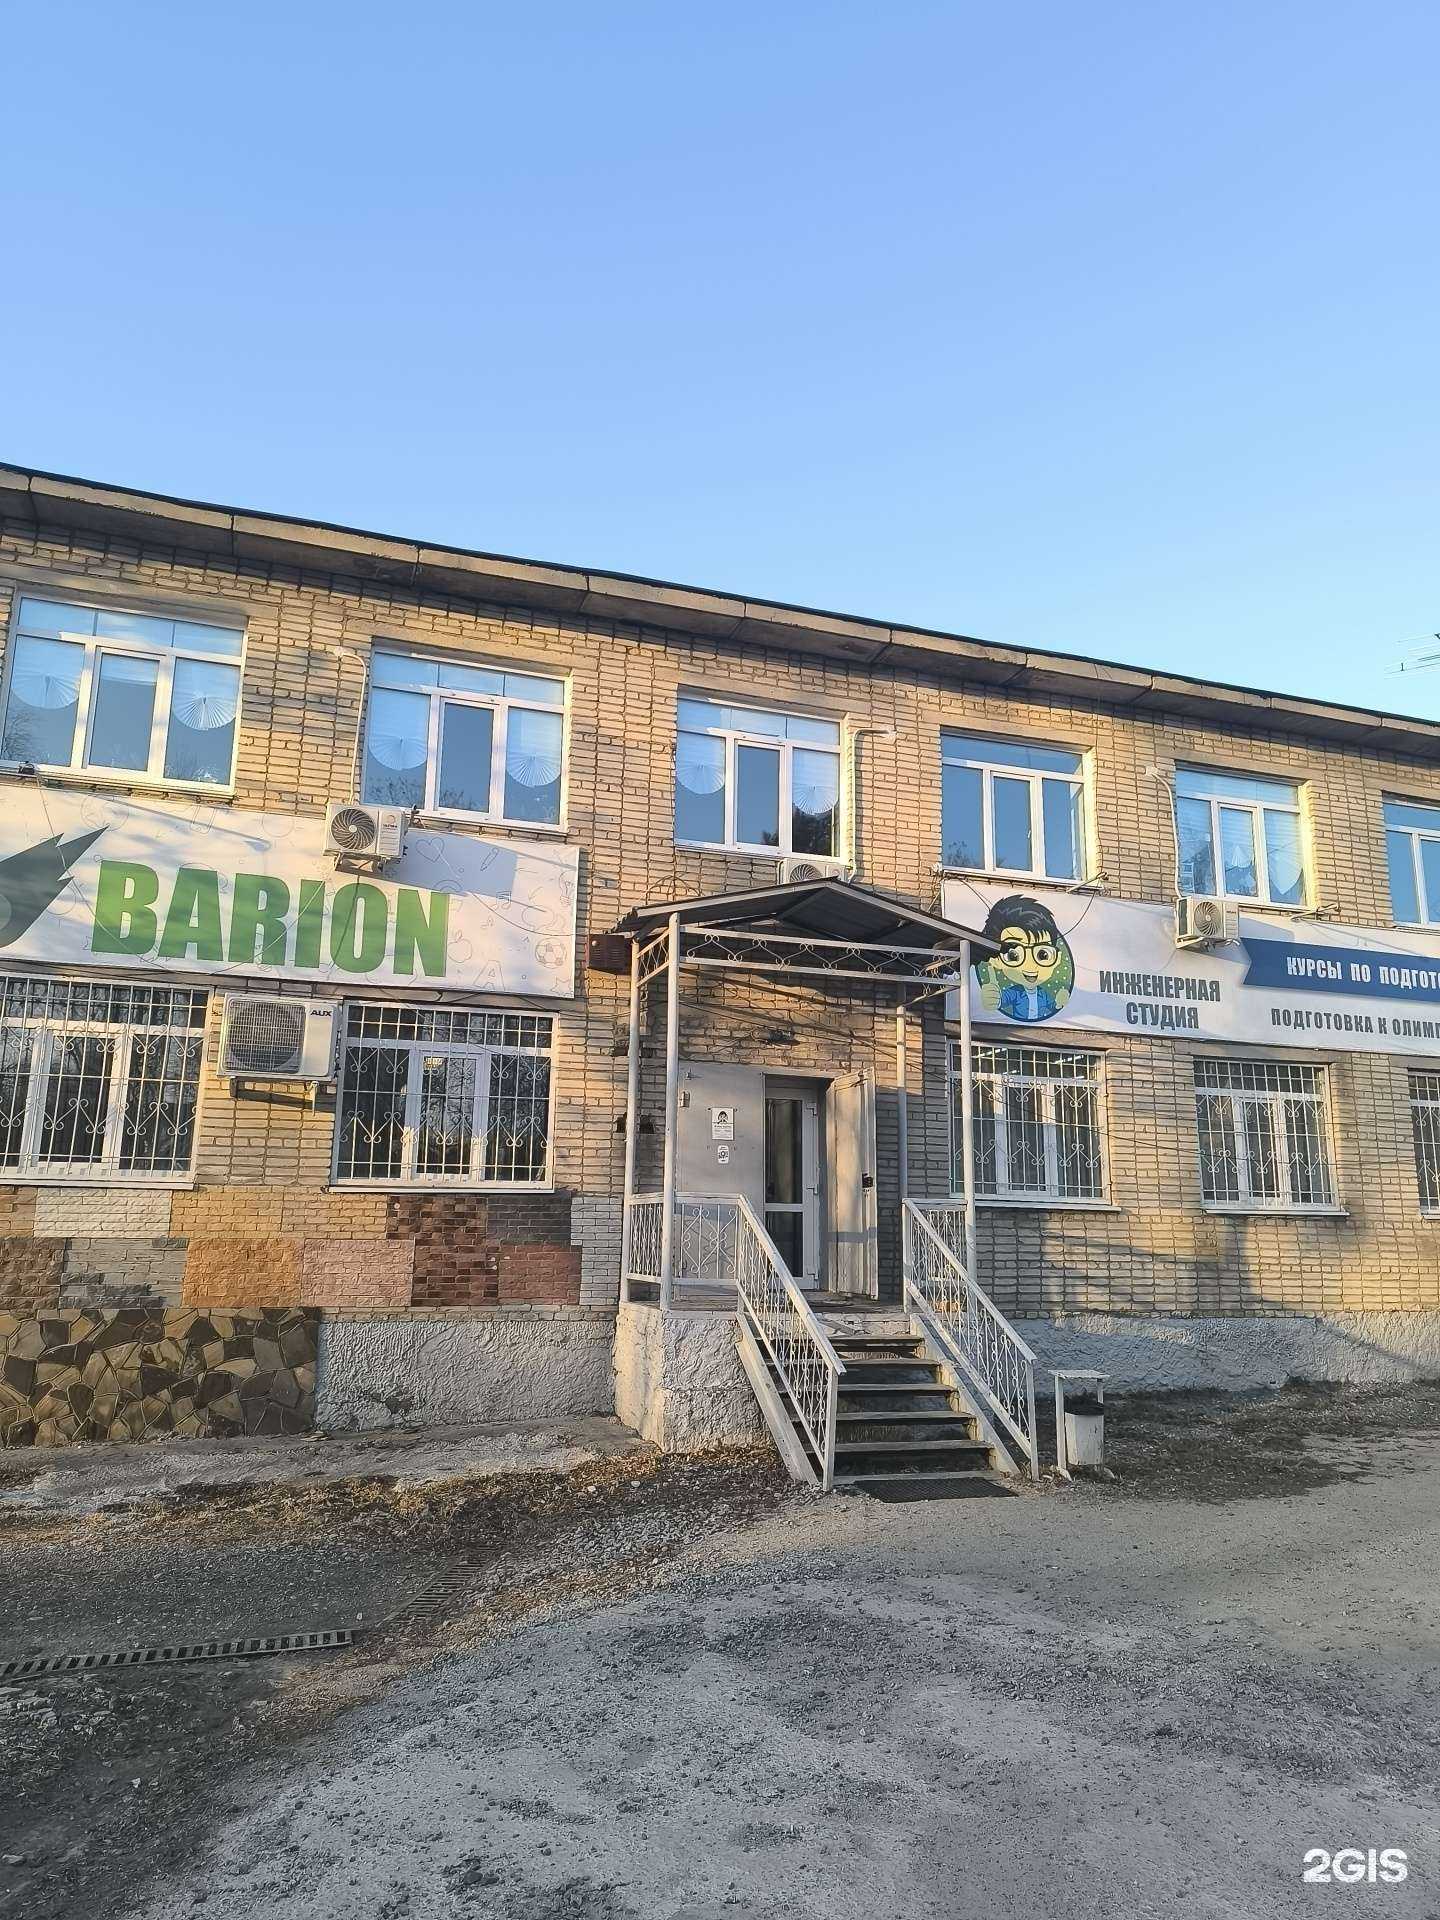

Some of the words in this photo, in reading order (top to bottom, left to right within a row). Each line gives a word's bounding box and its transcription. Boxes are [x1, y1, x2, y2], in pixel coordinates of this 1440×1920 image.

[91, 859, 451, 977] BARION
[1099, 970, 1221, 1002] ИНЖЕНЕРНАЯ
[1286, 956, 1343, 980] КУРСЫ
[1350, 963, 1371, 983] ПО
[1379, 965, 1440, 990] ПОДГОТ
[310, 1009, 332, 1017] AUX
[1126, 1001, 1200, 1031] СТУДИЯ
[1271, 1008, 1374, 1033] ПОДГОТОВКА
[1377, 1017, 1388, 1035] К
